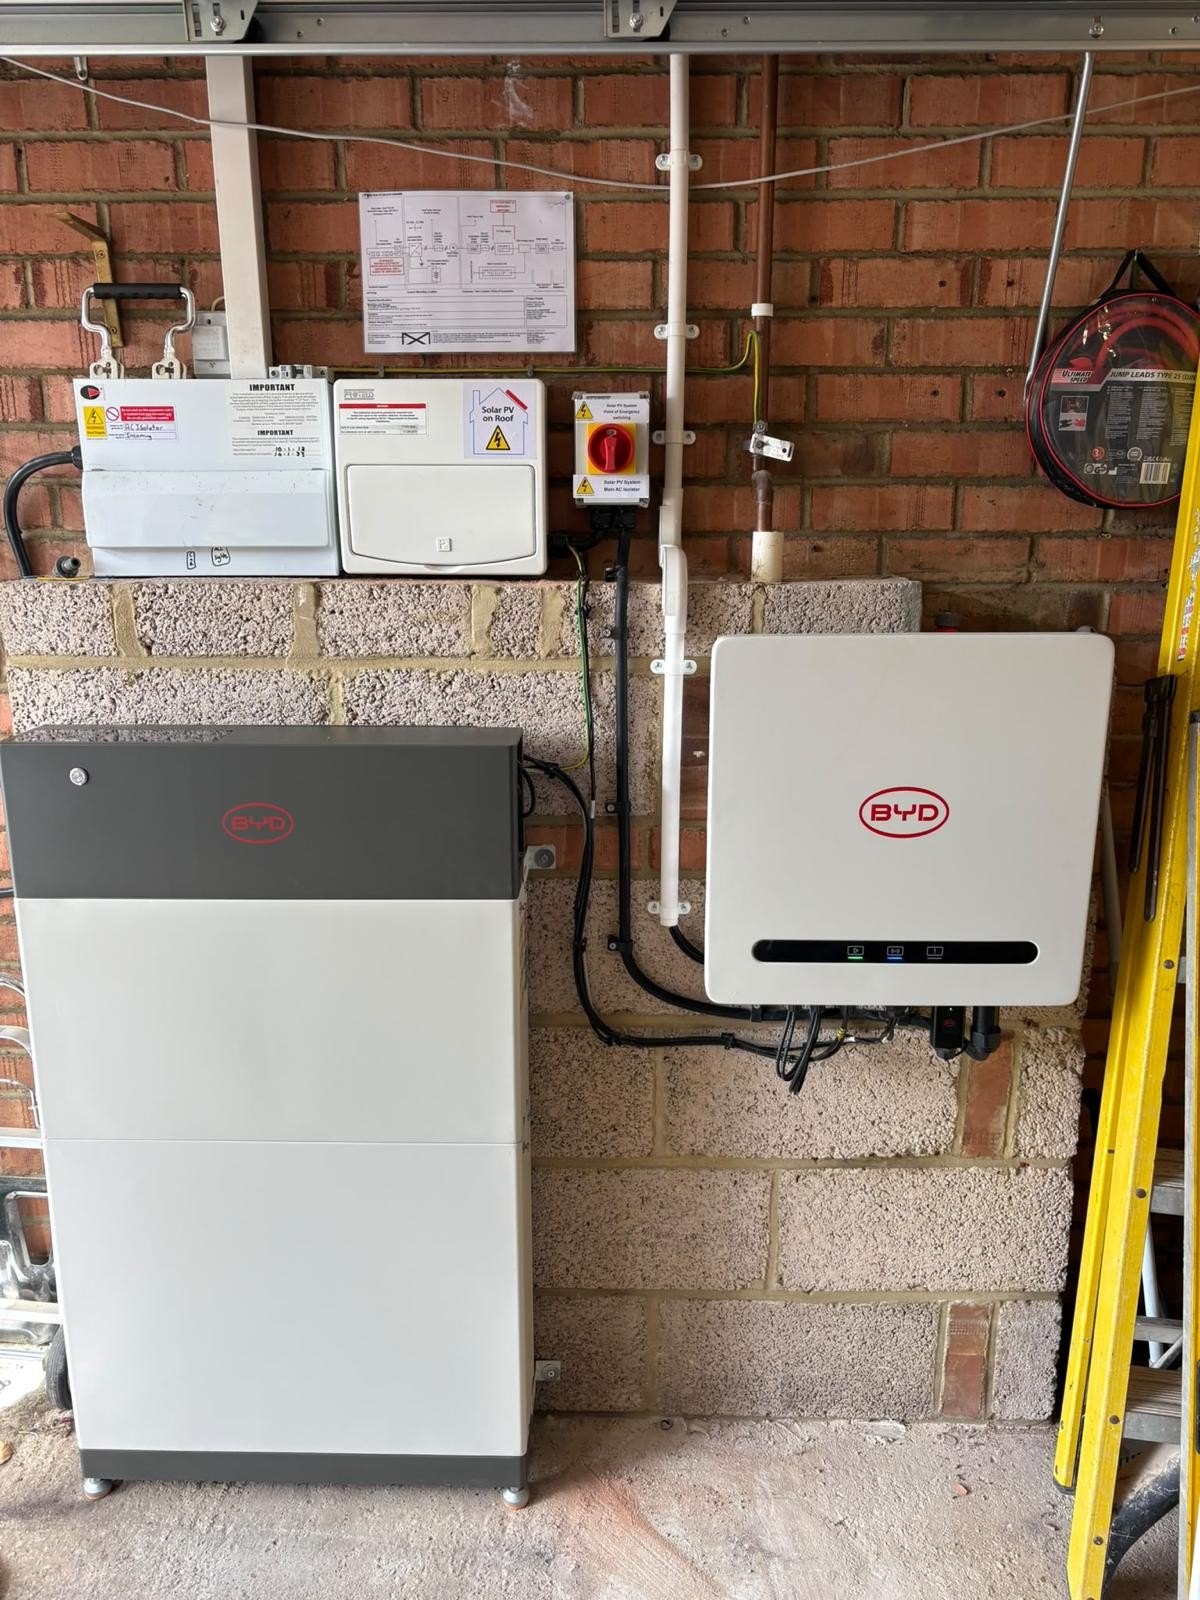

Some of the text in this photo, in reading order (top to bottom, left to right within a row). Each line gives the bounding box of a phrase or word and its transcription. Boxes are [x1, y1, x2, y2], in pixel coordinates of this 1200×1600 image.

[1130, 371, 1156, 379] LEADS
[249, 383, 296, 392] IMPORTANT
[481, 406, 515, 414] Solar PV
[494, 414, 514, 422] Roof
[870, 803, 940, 822] BYD
[231, 815, 287, 832] BYD
